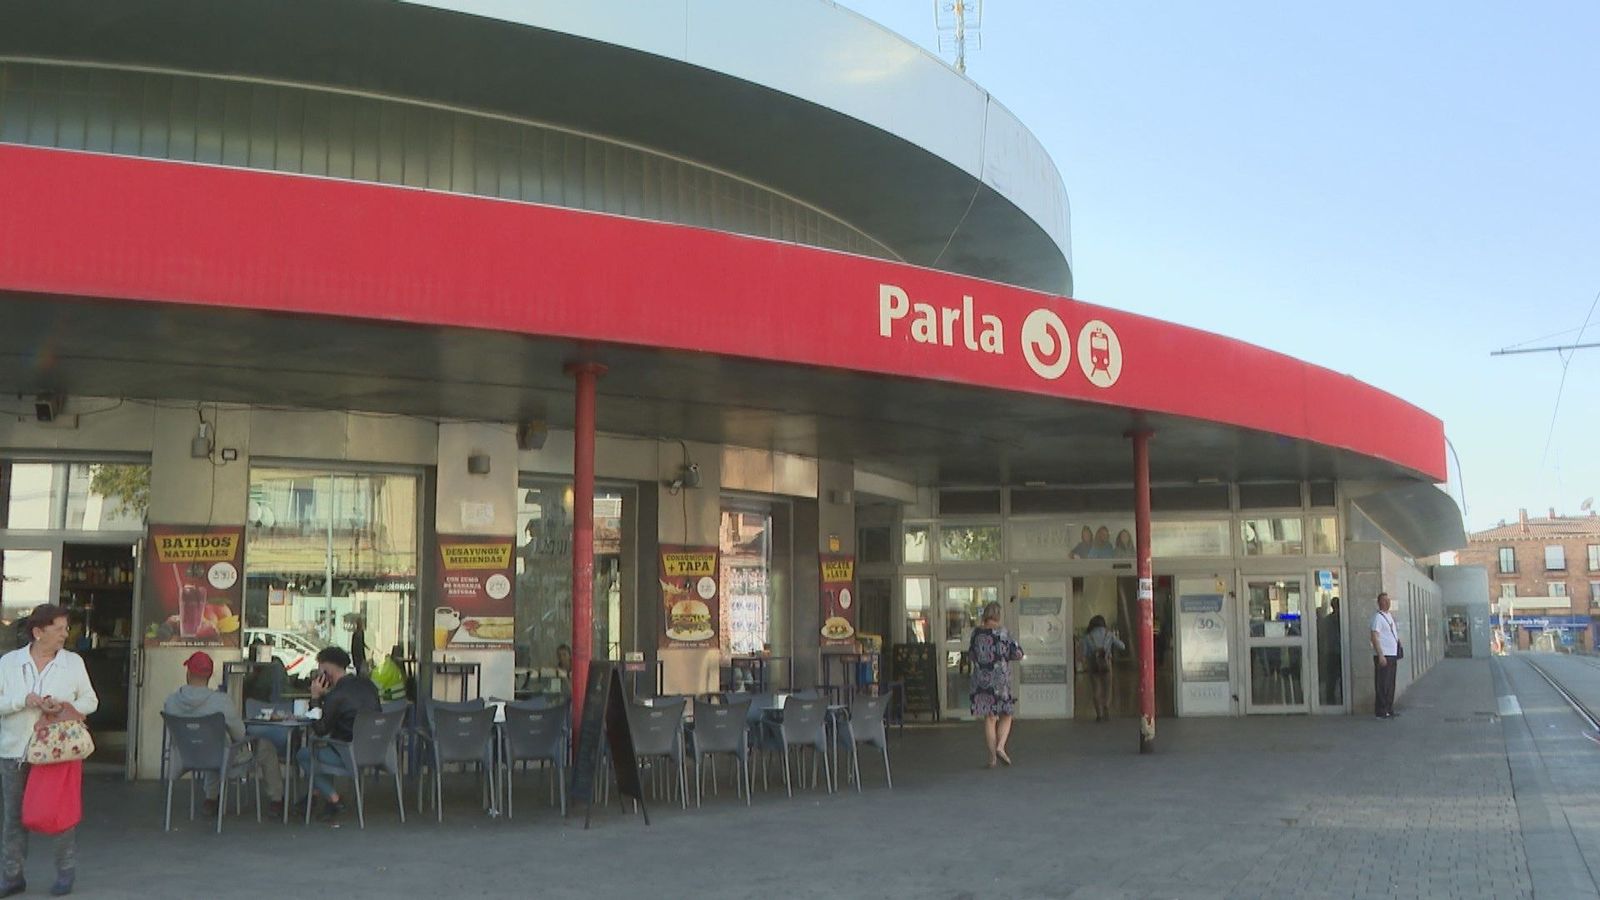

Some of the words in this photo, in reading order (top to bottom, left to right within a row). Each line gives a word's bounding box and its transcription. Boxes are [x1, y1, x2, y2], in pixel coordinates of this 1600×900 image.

[879, 283, 1004, 354] Parla
[162, 536, 231, 549] BATIDOS
[163, 549, 229, 558] NATURALES
[445, 547, 500, 556] DESAYUNOS
[501, 547, 507, 555] Y
[449, 556, 503, 564] MERIENDAS
[678, 561, 710, 572] TAPA
